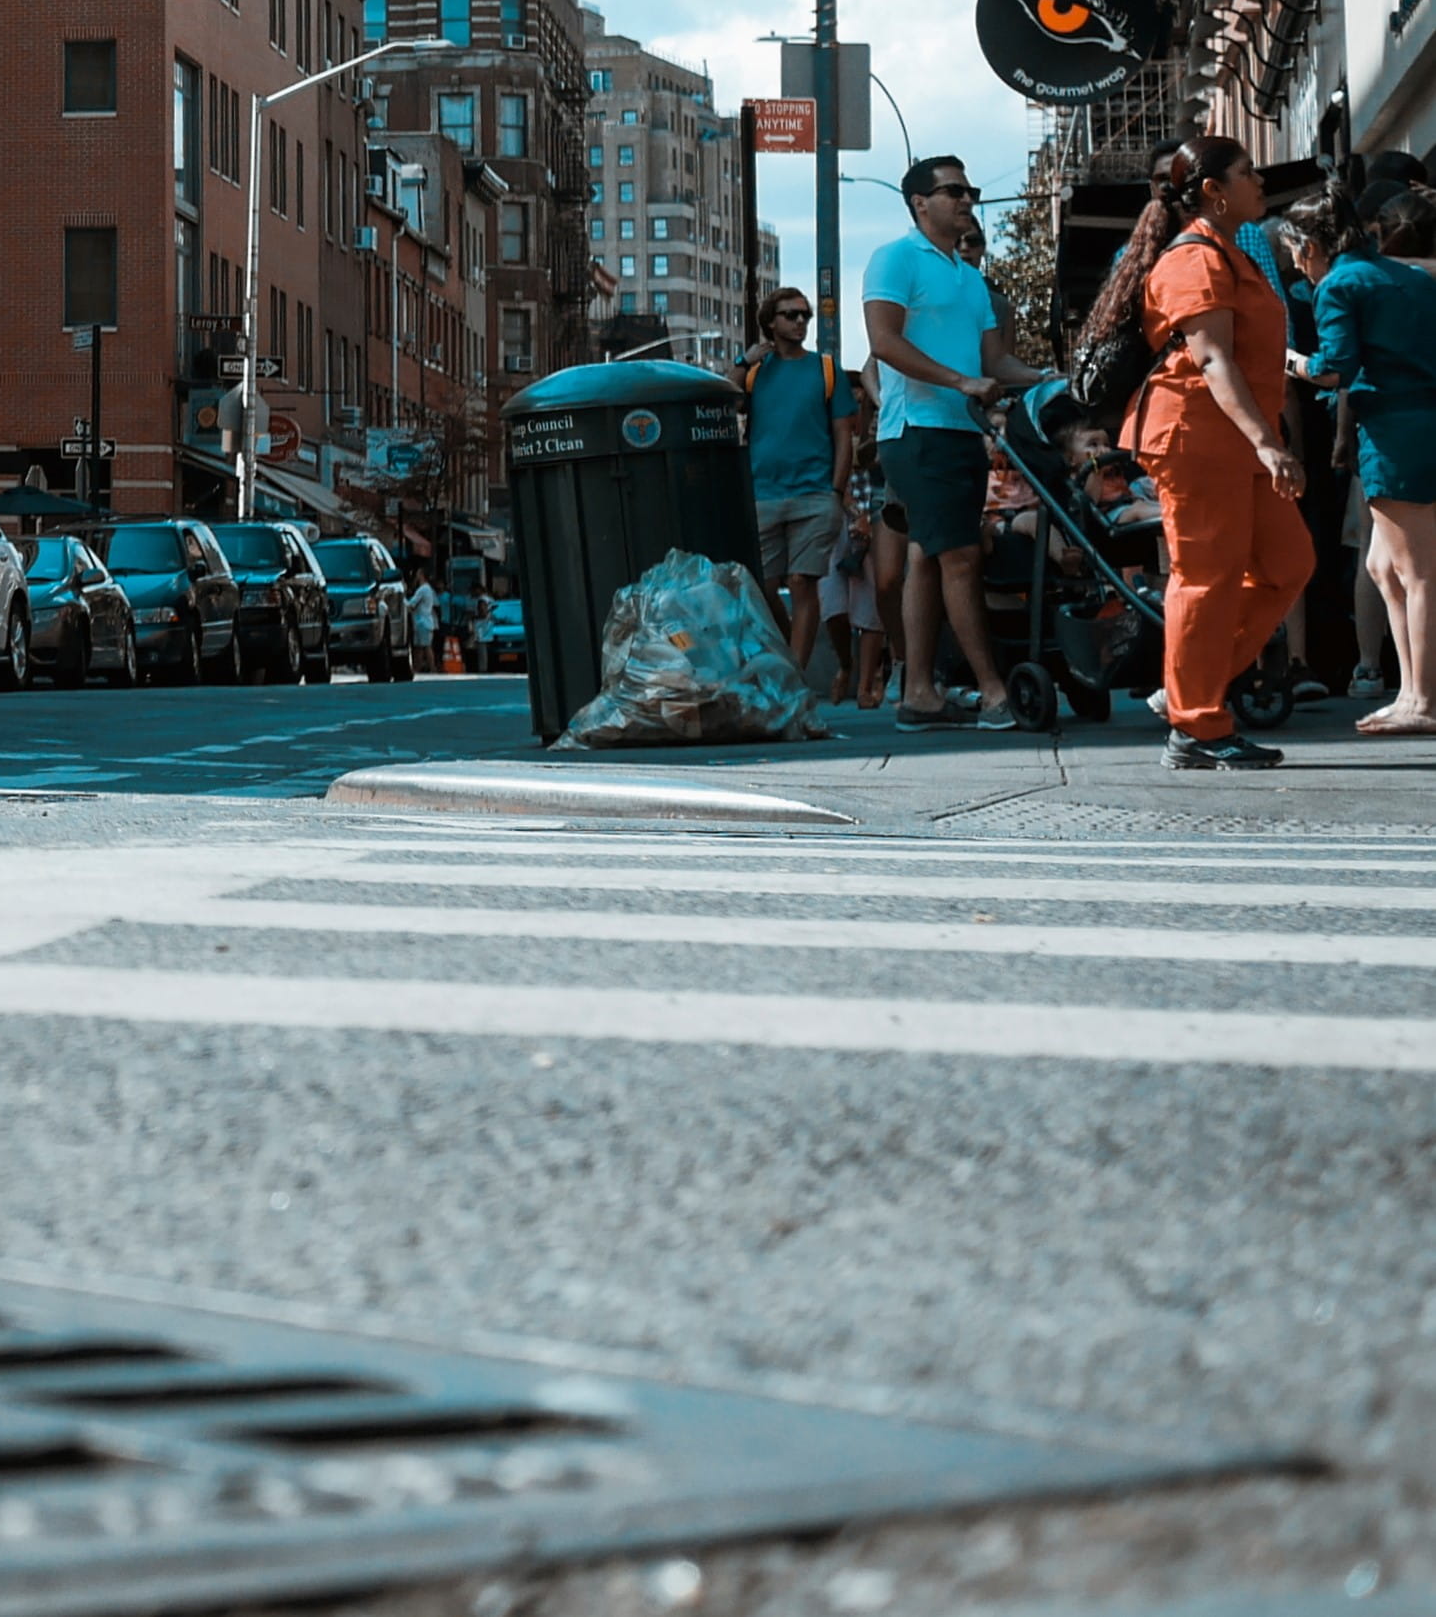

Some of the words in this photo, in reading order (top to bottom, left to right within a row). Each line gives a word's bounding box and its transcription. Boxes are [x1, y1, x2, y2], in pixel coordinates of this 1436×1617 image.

[1013, 68, 1034, 88] the
[1035, 82, 1094, 97] gourmet
[1095, 66, 1127, 89] wrap
[765, 102, 811, 115] STOPPING
[756, 118, 804, 131] ANYTIME
[191, 318, 217, 332] Leroy
[220, 318, 231, 330] St
[696, 405, 722, 422] Keep
[527, 414, 574, 434] Council
[691, 425, 729, 441] District
[536, 439, 543, 455] 2
[545, 438, 584, 454] Clean
